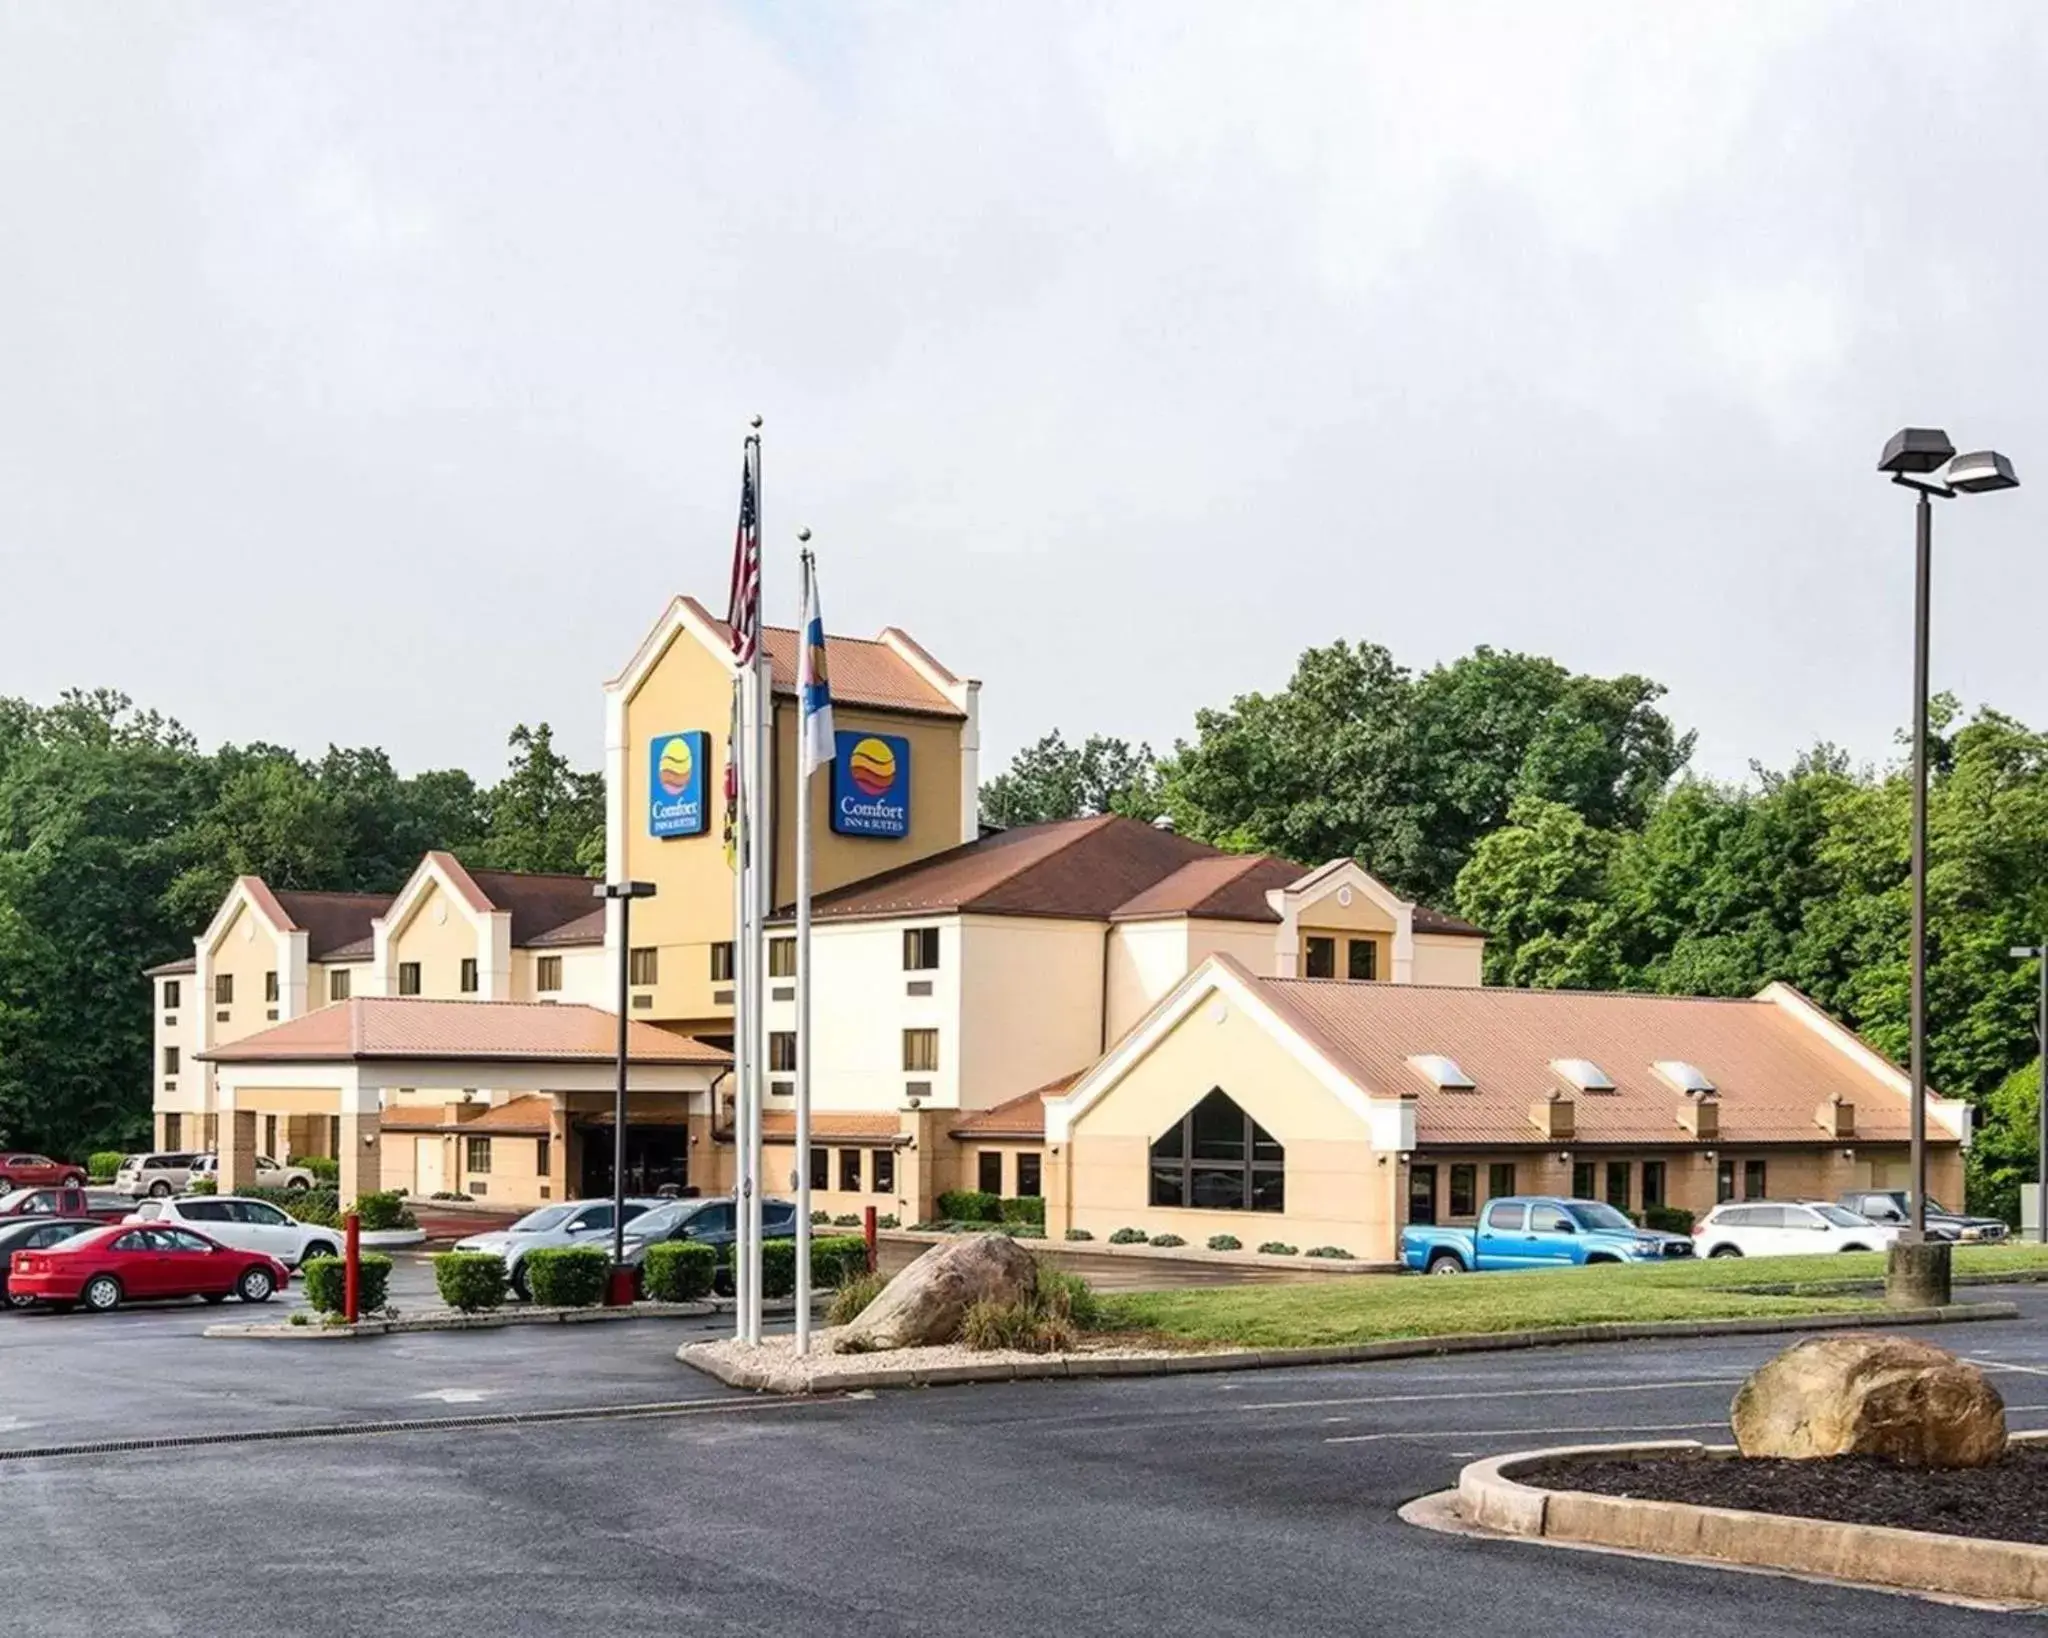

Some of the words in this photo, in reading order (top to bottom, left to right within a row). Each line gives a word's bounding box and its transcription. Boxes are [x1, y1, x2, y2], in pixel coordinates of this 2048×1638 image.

[652, 796, 698, 819] Comfort
[841, 795, 904, 819] Comfort
[844, 816, 862, 827] INN
[871, 819, 904, 831] SUITES
